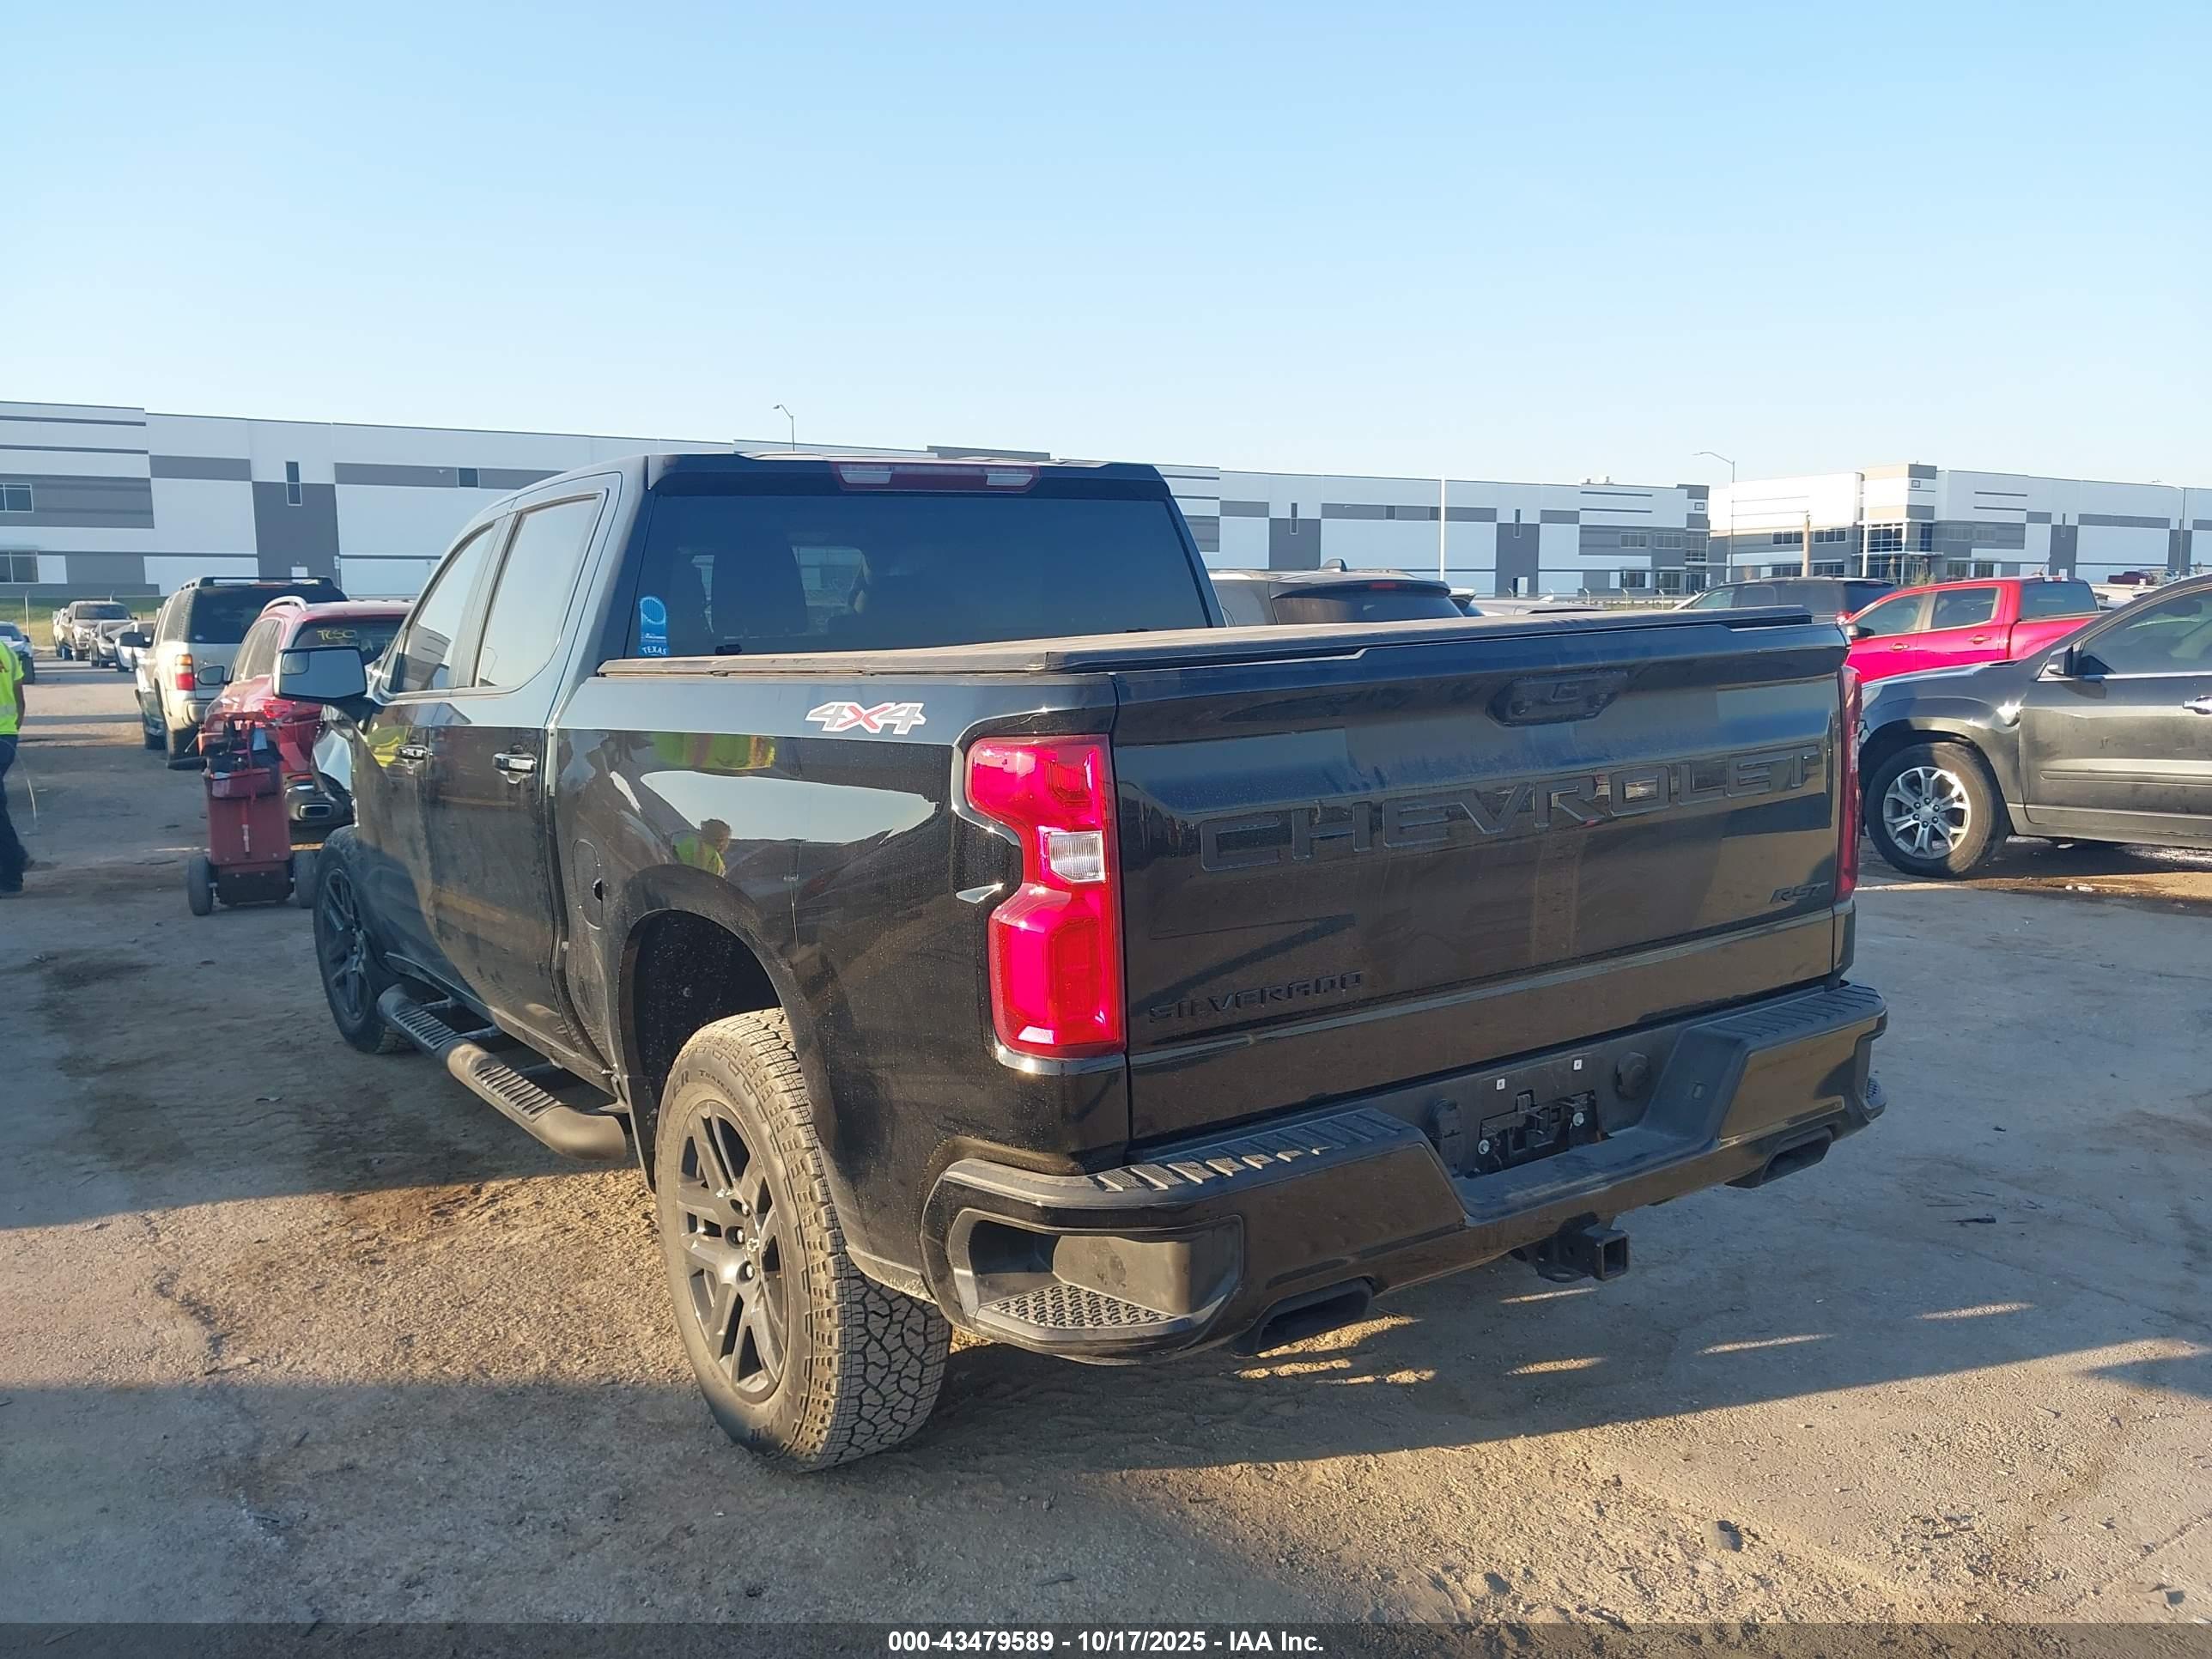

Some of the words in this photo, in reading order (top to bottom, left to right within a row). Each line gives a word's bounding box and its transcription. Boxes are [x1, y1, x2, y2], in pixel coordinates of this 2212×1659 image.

[641, 645, 667, 655] TEXAS
[1200, 743, 1819, 872] CHEVROLET
[1769, 881, 1829, 903] RST
[1149, 969, 1364, 1023] SILVERADO
